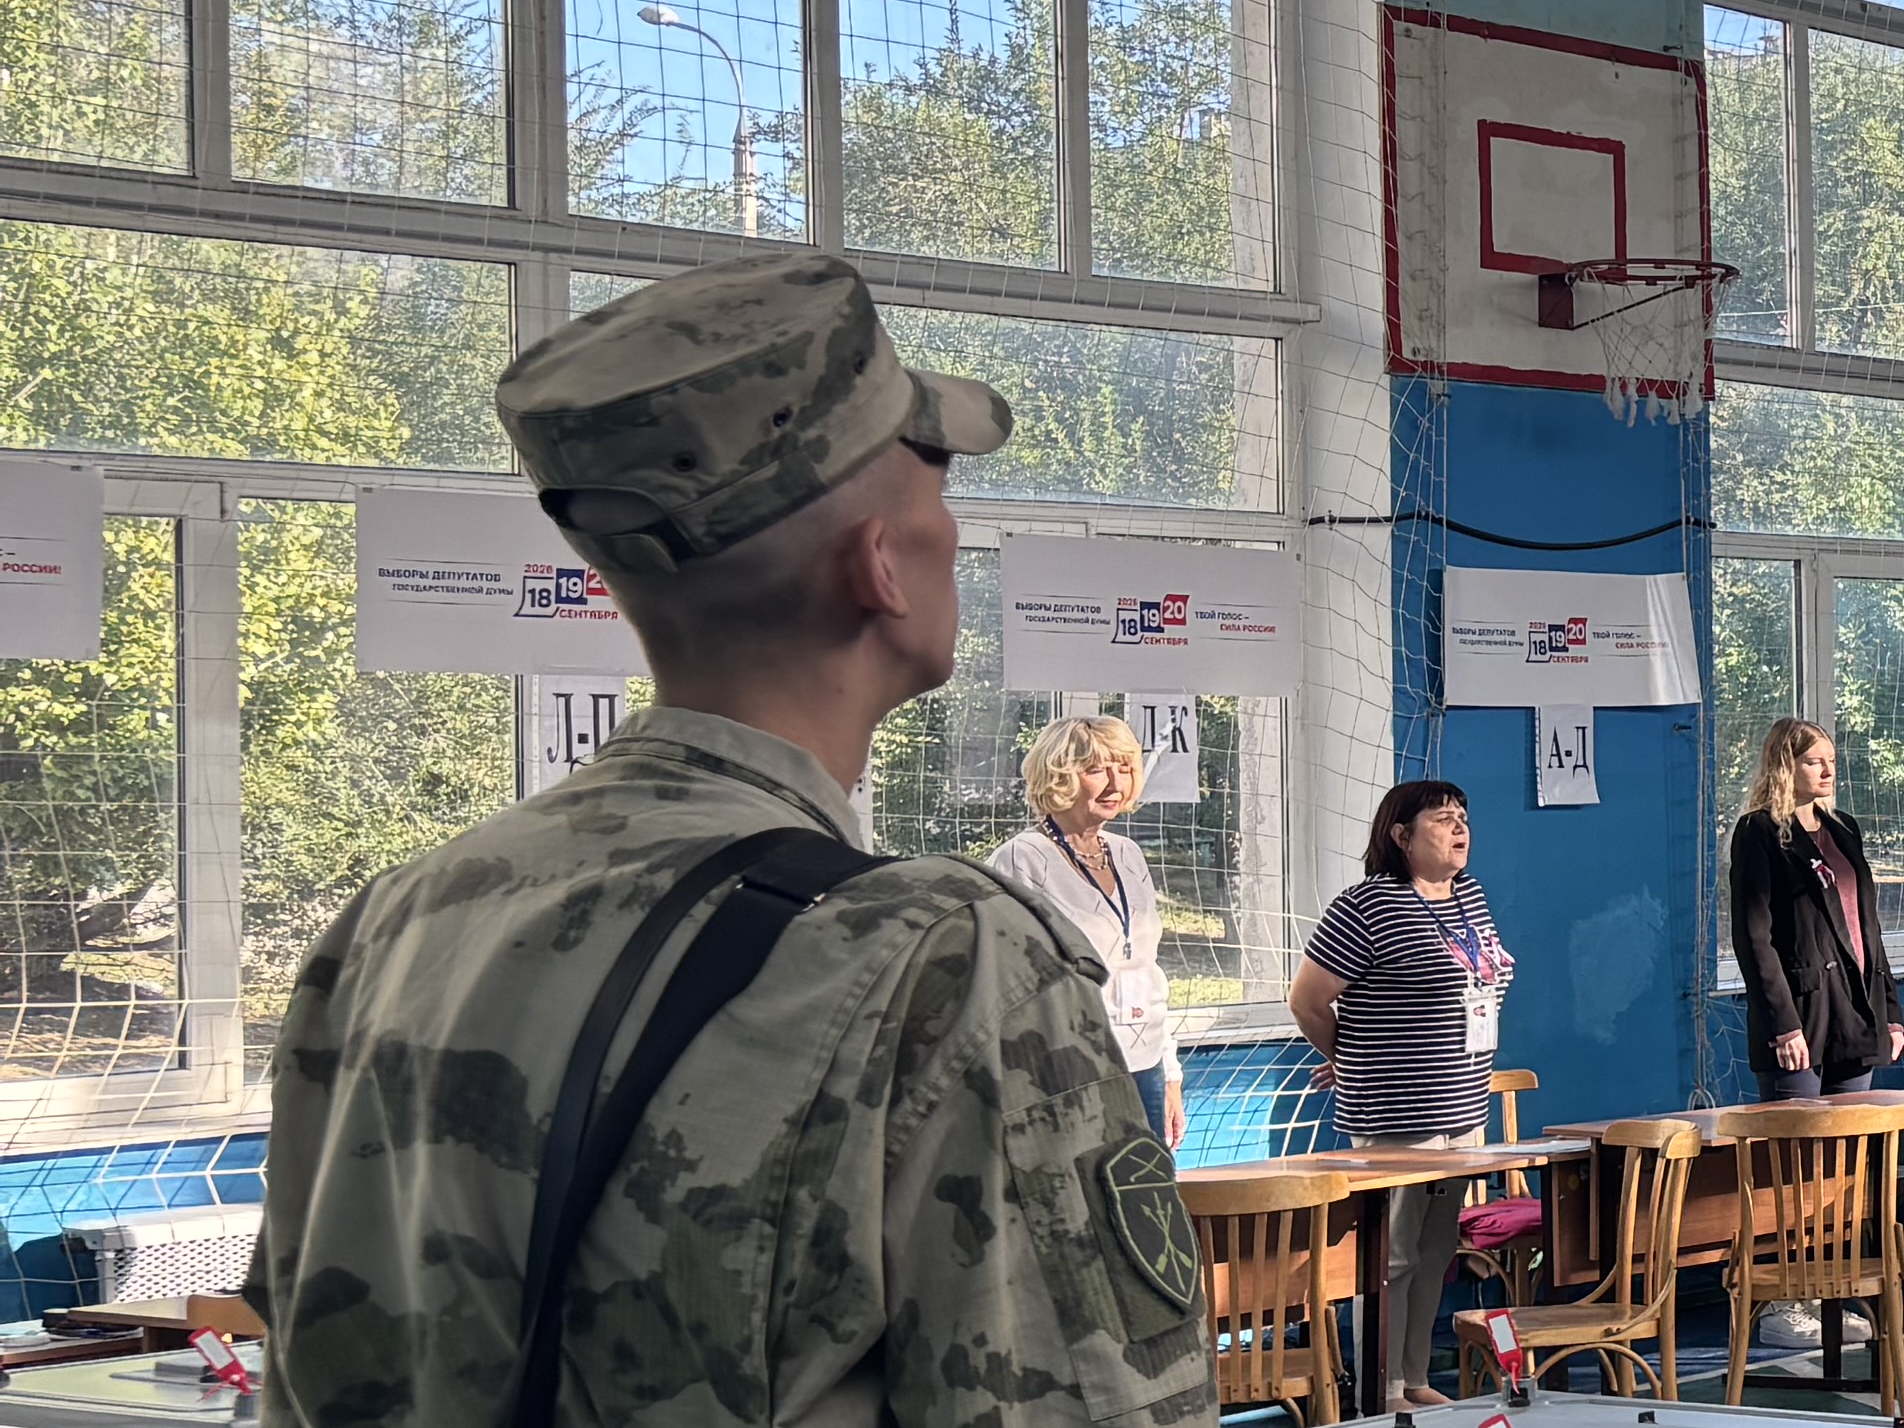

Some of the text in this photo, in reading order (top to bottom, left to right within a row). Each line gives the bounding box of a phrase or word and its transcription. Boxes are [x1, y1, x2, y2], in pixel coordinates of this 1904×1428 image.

[378, 567, 501, 582] ВЫБОРЫ ДЕПУТАТОВ
[528, 588, 552, 608] 18
[558, 577, 583, 598] 19
[559, 608, 618, 619] СЕНТЯБРЯ
[1120, 601, 1184, 636] 18 19 20
[1195, 610, 1216, 621] ТВОЙ
[1144, 637, 1188, 646] СЕНТЯБРЯ
[1532, 623, 1585, 655] 18 19 20
[546, 693, 619, 764] Л-П
[1547, 725, 1591, 779] А-Д
